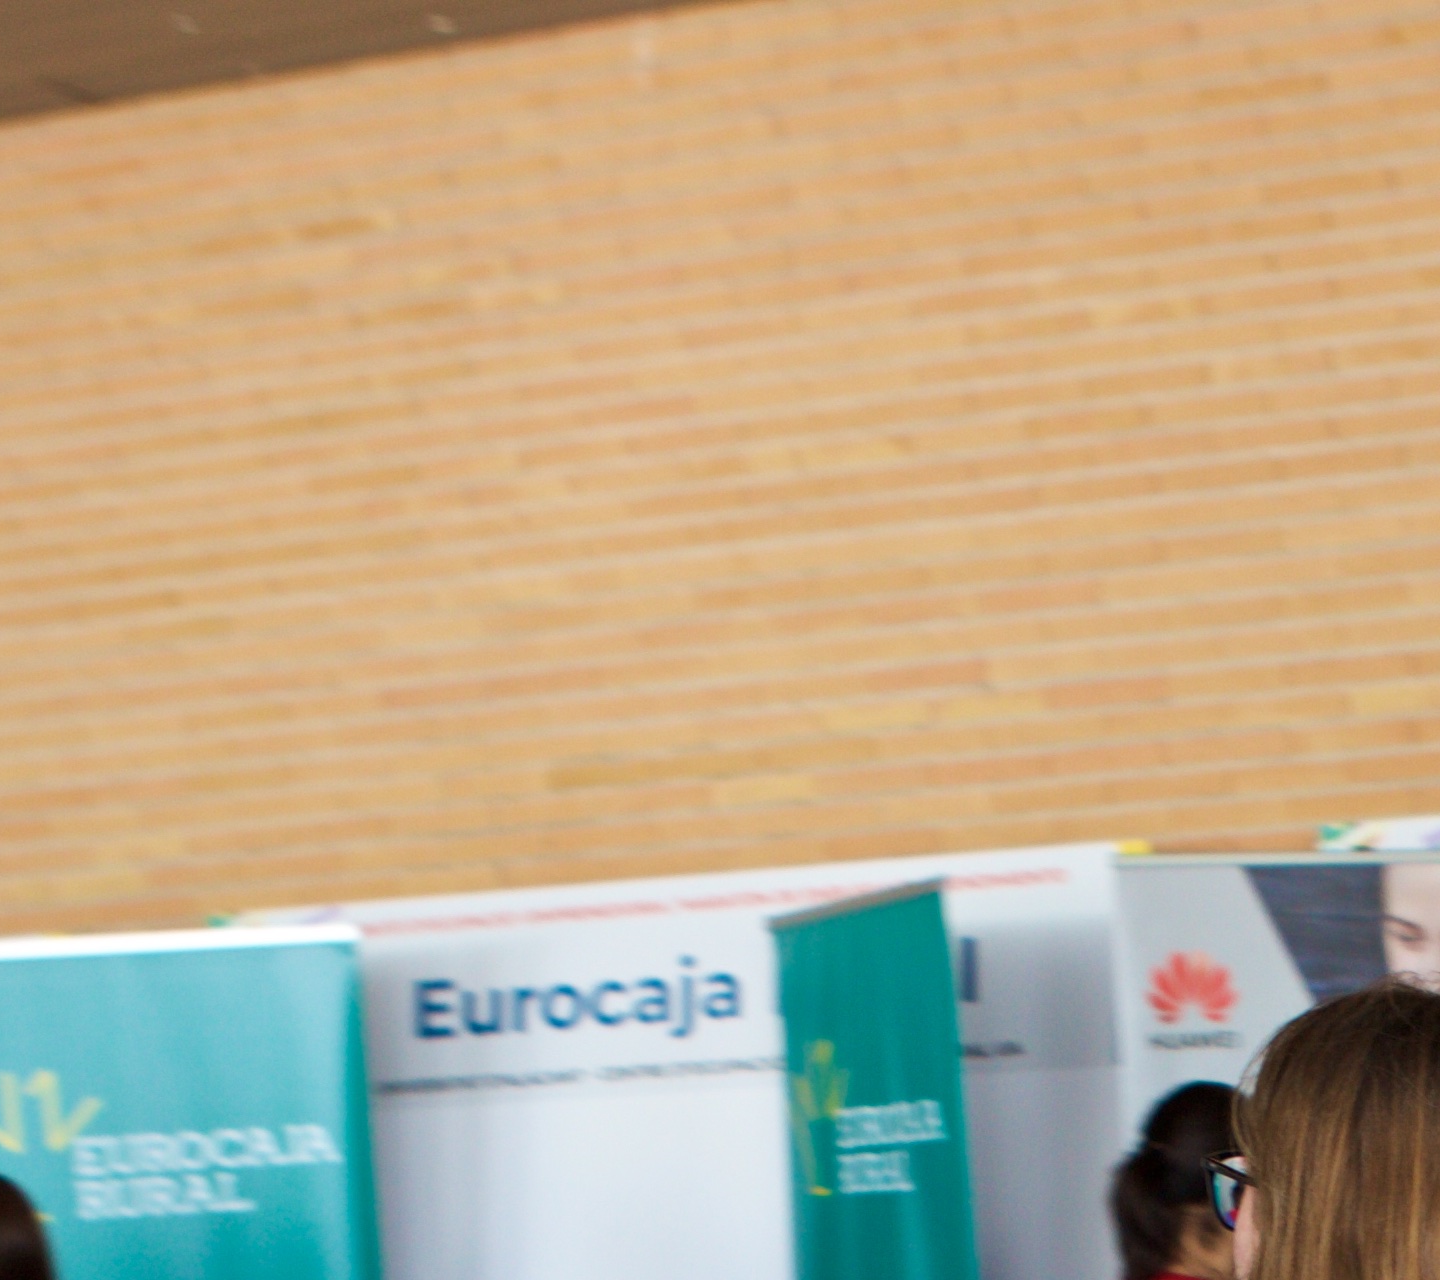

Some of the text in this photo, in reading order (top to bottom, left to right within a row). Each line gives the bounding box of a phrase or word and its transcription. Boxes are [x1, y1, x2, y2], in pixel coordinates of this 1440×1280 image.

[412, 954, 741, 1038] Eurocaja
[72, 1124, 342, 1176] EUROCAJA
[74, 1171, 255, 1220] RURAL
